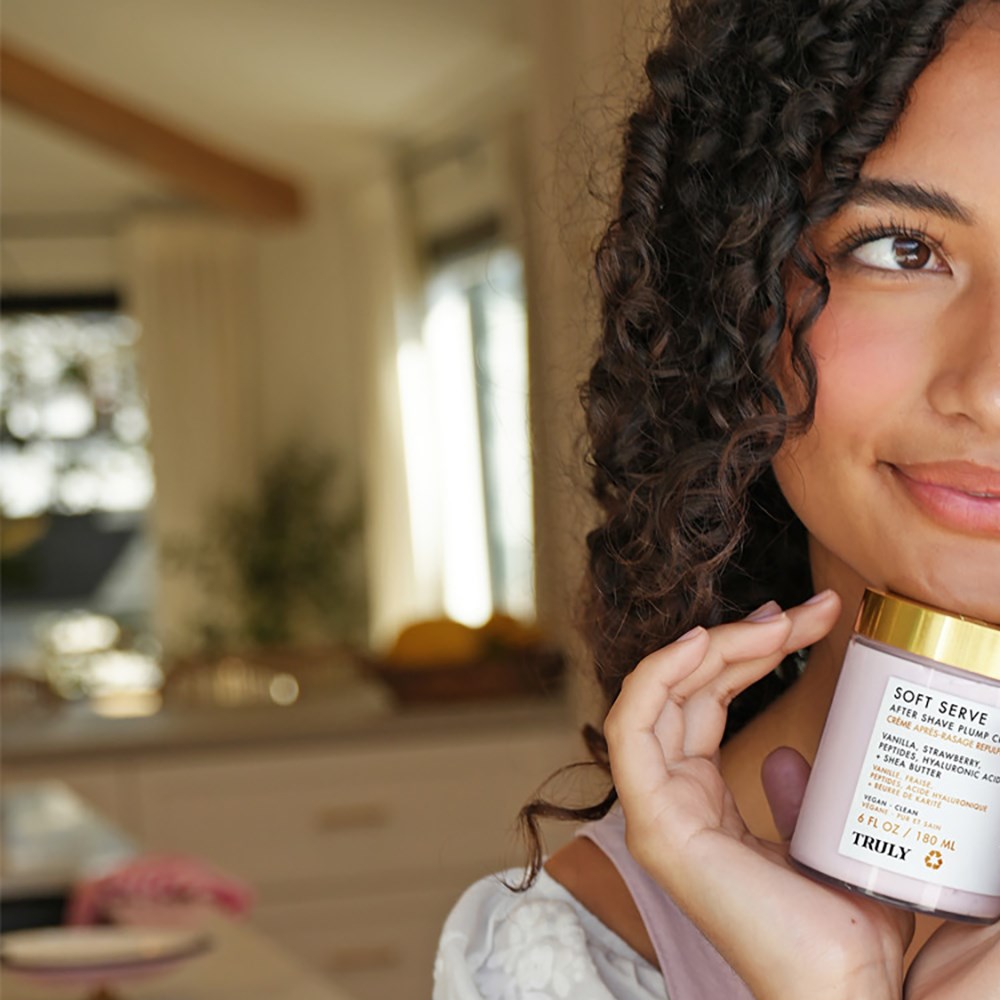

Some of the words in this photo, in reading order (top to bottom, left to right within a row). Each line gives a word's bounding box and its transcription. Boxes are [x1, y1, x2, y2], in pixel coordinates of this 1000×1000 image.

[894, 686, 932, 708] SOFT
[938, 701, 988, 725] SERVE
[889, 704, 917, 719] AFTER
[921, 714, 954, 731] SHAVE
[958, 725, 989, 739] PLUMP
[878, 742, 918, 762] PEPTIDES,
[922, 757, 980, 779] HYALURONIC
[882, 732, 918, 751] VANILLA,
[922, 745, 981, 769] STRAWBERRY,
[883, 755, 906, 768] SHEA
[909, 763, 942, 778] BUTTER
[864, 794, 887, 806] VEGAN
[894, 804, 919, 816] CLEAN
[874, 783, 900, 794] BEURRE
[902, 792, 912, 800] DE
[906, 785, 929, 796] ACIDE
[932, 792, 989, 812] HYALURONIQUE
[857, 813, 864, 823] 6
[867, 816, 879, 828] FL
[882, 821, 899, 835] OZ
[903, 828, 911, 838] /
[917, 831, 938, 846] 180
[941, 840, 957, 851] ML
[896, 813, 910, 821] PUR
[924, 821, 942, 831] SAIN
[852, 831, 912, 861] TRULY
